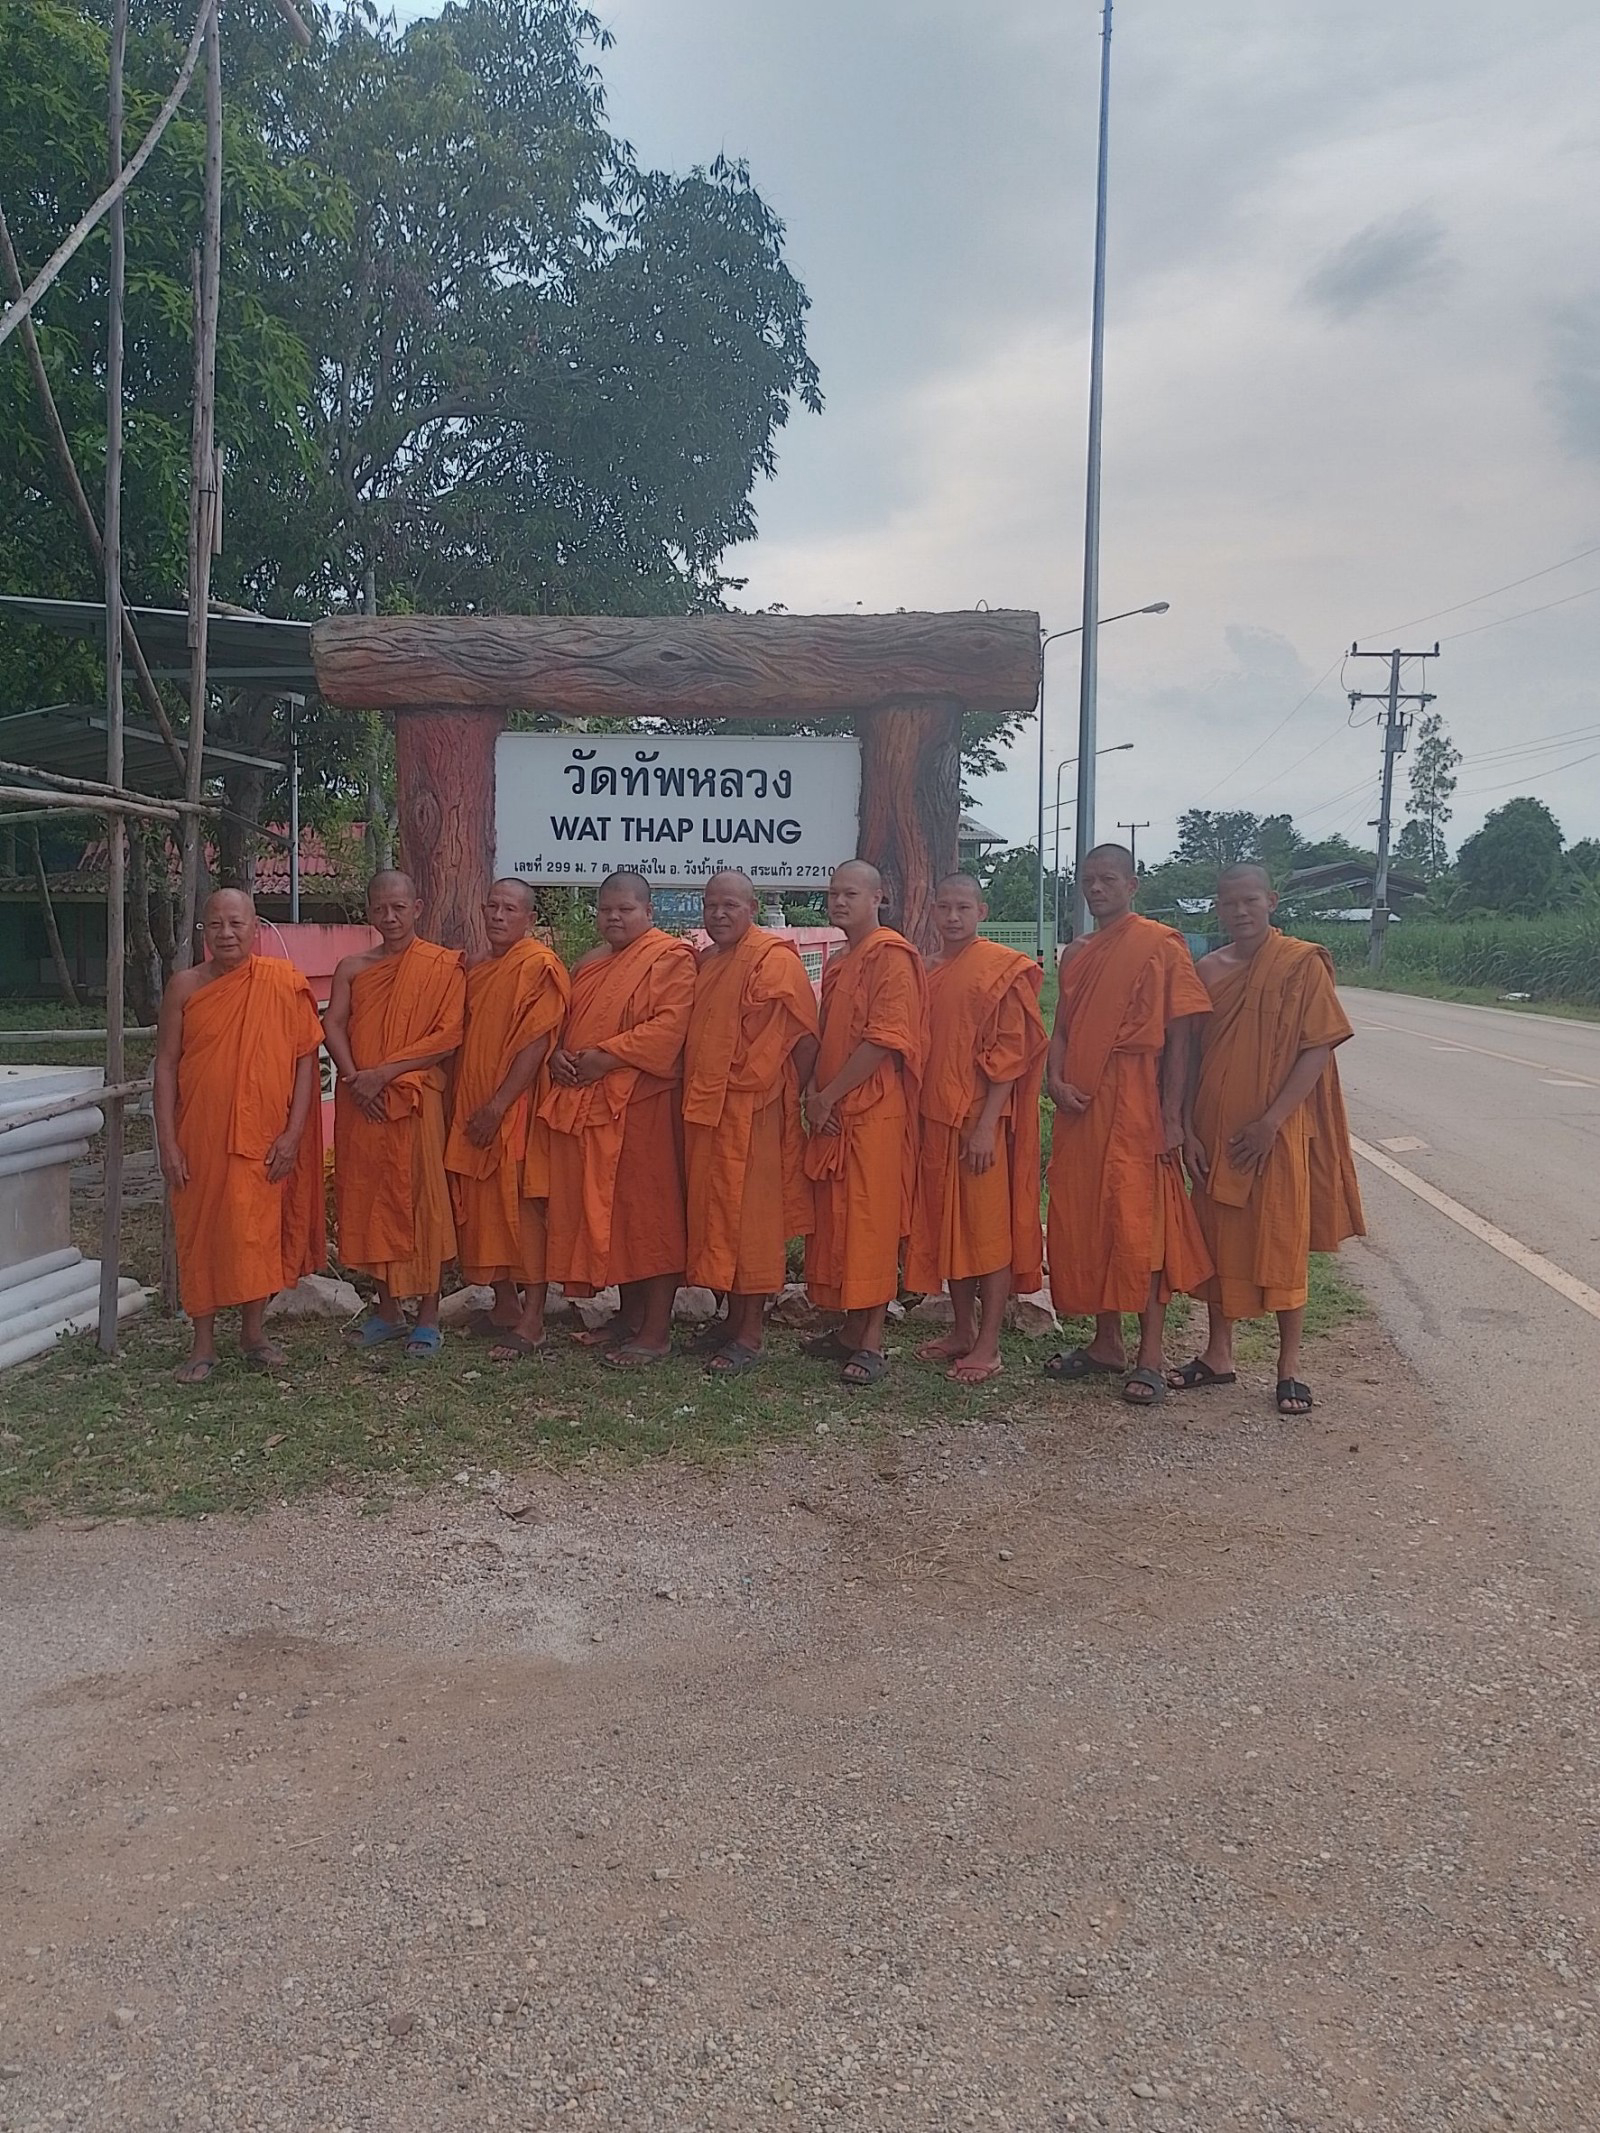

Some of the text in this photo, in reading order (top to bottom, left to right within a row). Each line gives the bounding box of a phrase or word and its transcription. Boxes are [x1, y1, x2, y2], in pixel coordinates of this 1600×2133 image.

[563, 748, 792, 799] วัดทัพหลวง
[550, 816, 802, 844] WAT THAP LUANG
[514, 854, 542, 872] เลขที่
[546, 861, 571, 873] 299
[575, 862, 586, 873] ม.
[591, 862, 598, 873] 7
[670, 864, 680, 875] อ.
[750, 861, 793, 877] สระแก้ว
[796, 866, 836, 877] 27210
